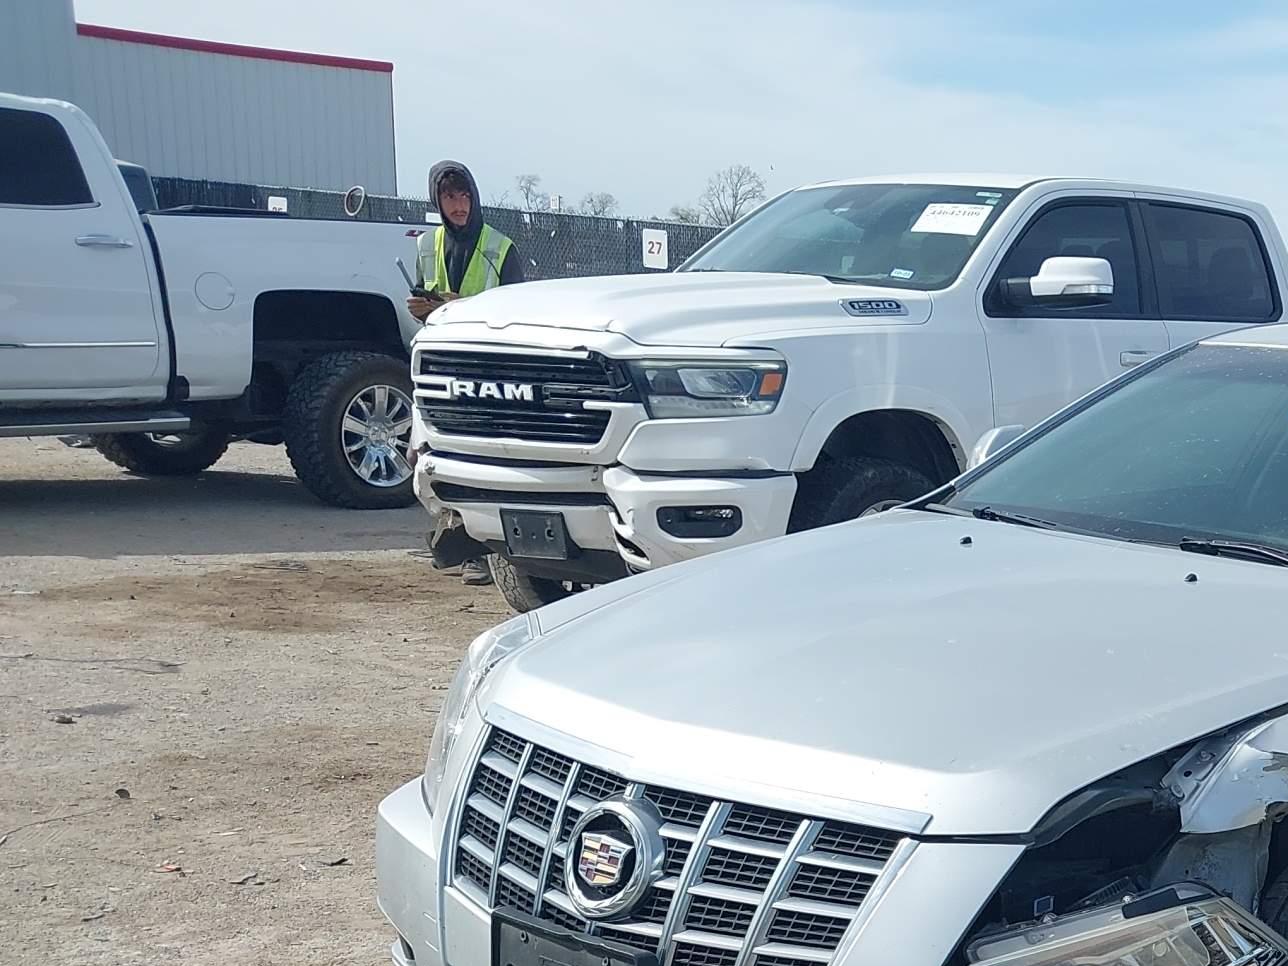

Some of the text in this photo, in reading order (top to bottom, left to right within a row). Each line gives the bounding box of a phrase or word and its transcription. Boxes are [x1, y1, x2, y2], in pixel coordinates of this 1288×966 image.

[647, 240, 663, 255] 27
[851, 301, 897, 309] 1500
[452, 380, 534, 402] RAM
